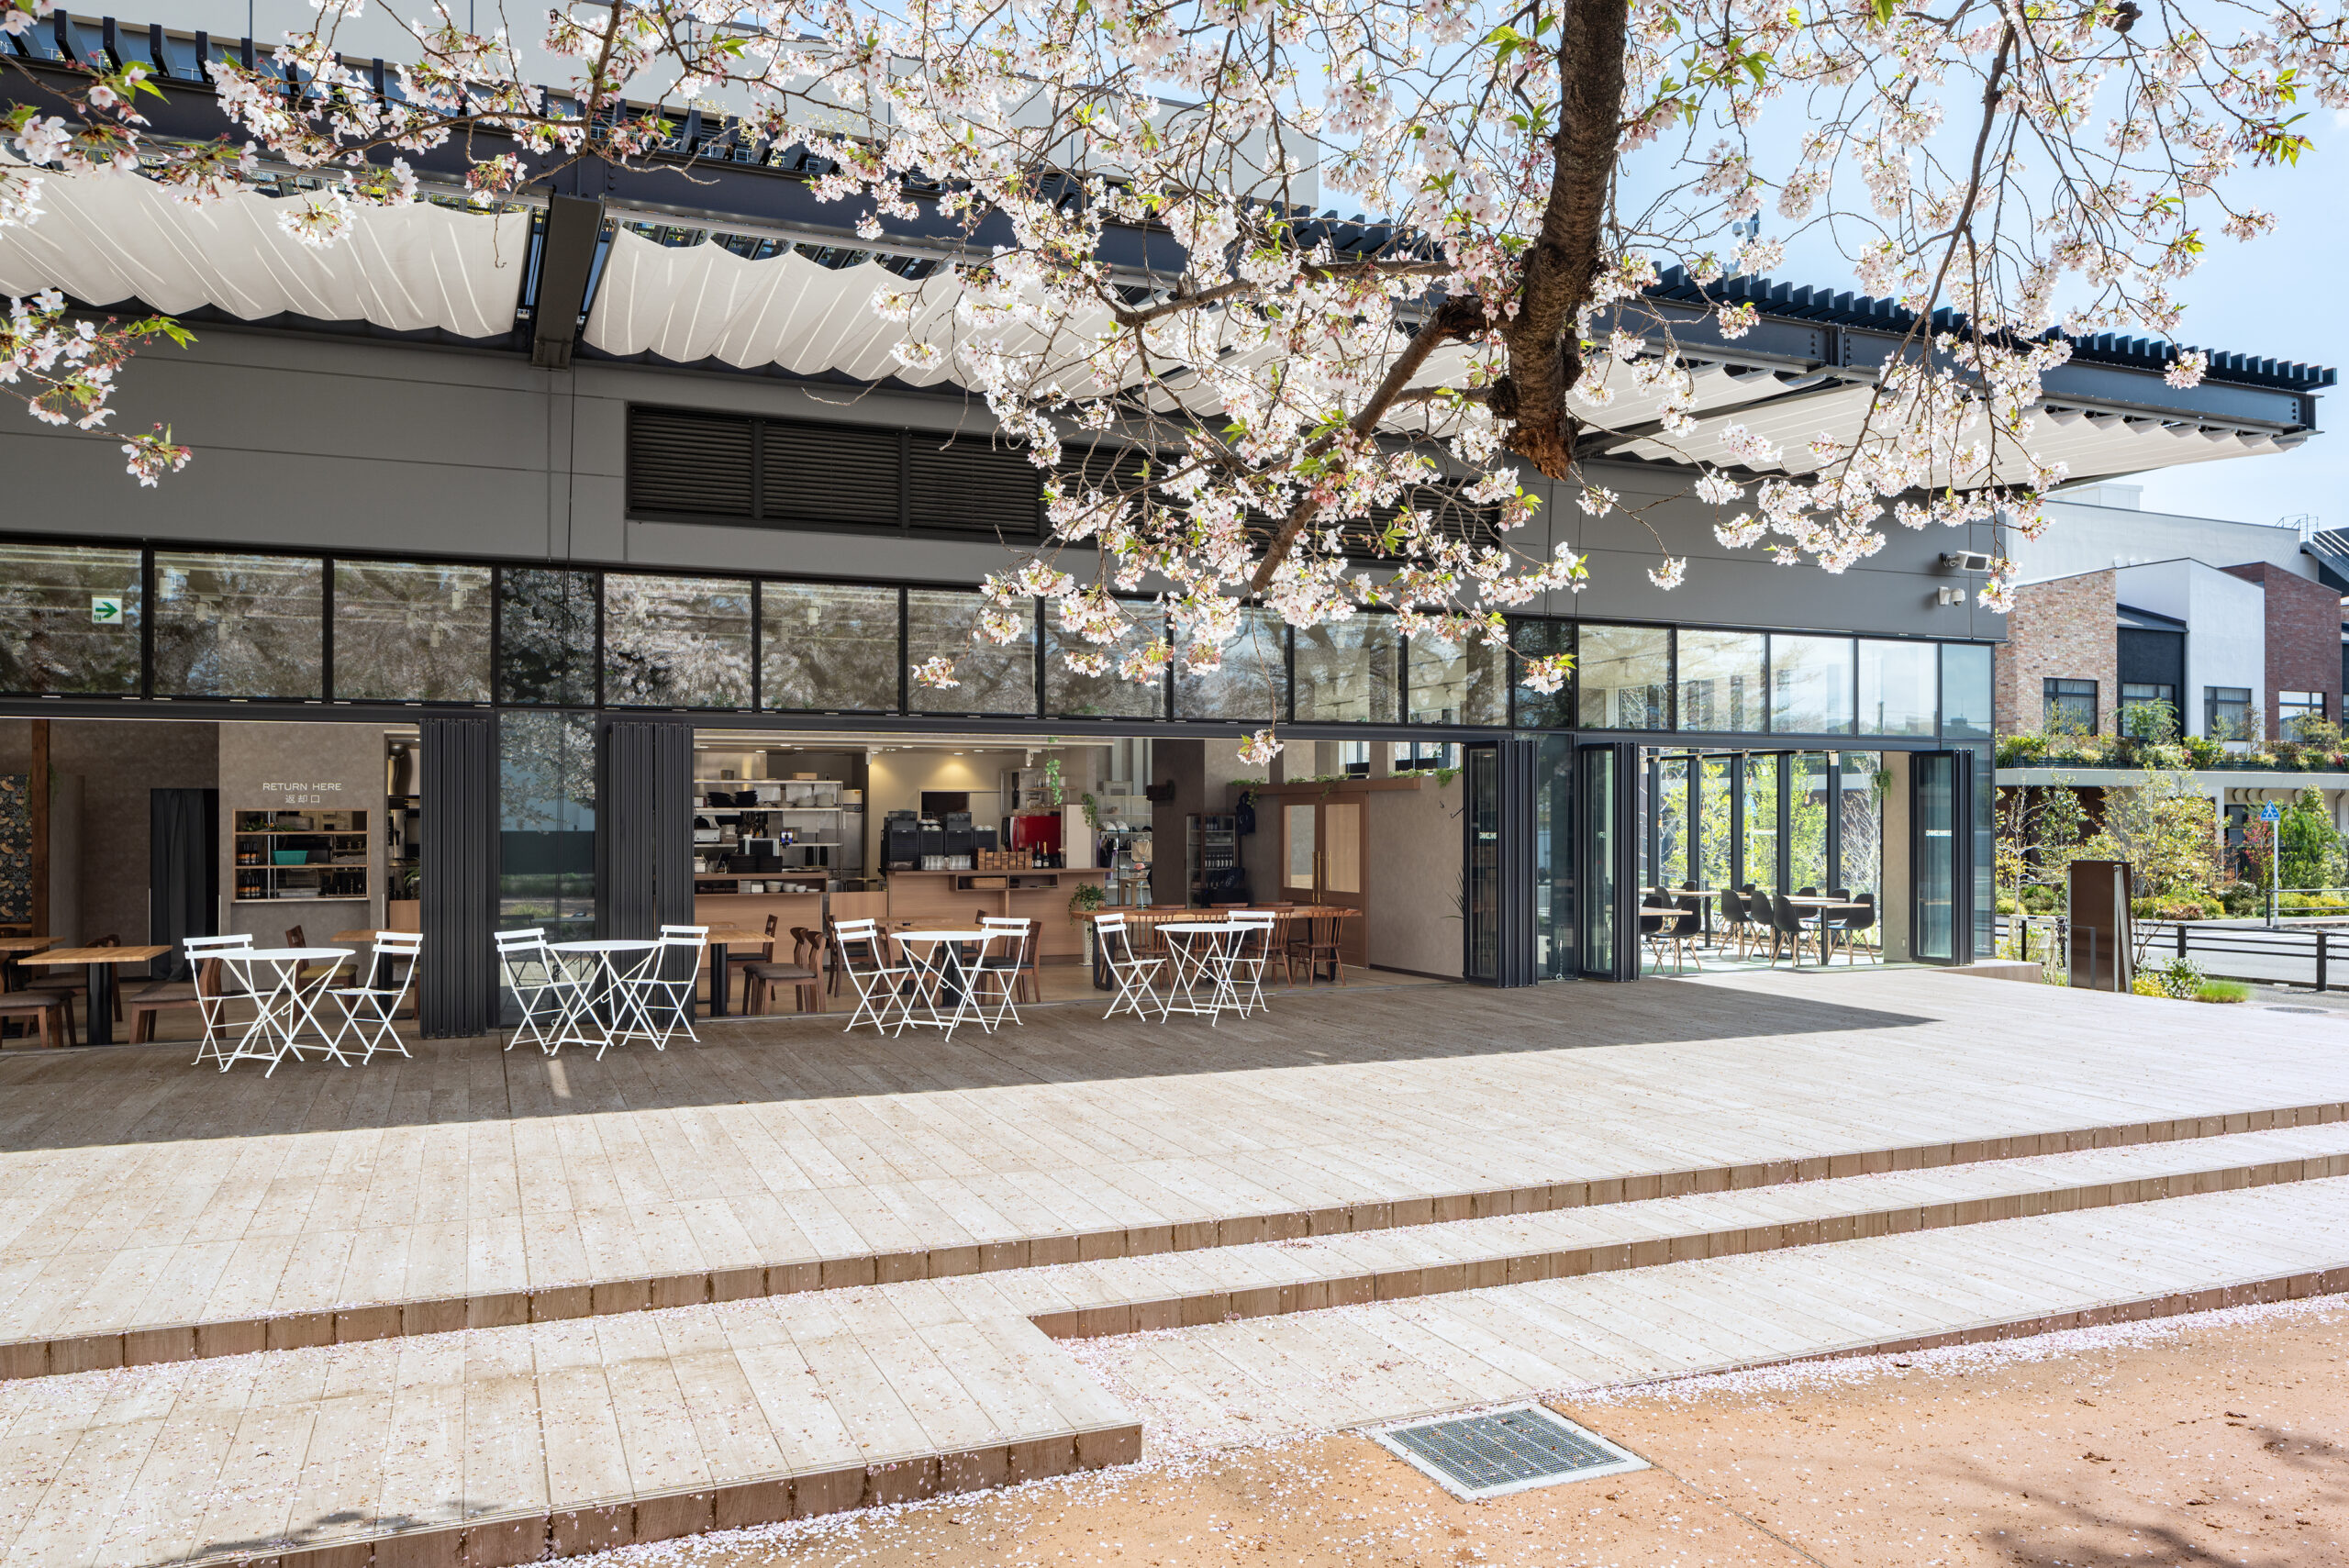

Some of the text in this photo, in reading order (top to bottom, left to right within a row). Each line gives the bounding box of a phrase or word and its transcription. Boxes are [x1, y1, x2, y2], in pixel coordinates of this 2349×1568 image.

[262, 783, 342, 791] RETURN HERE
[285, 795, 320, 804] 返却口
